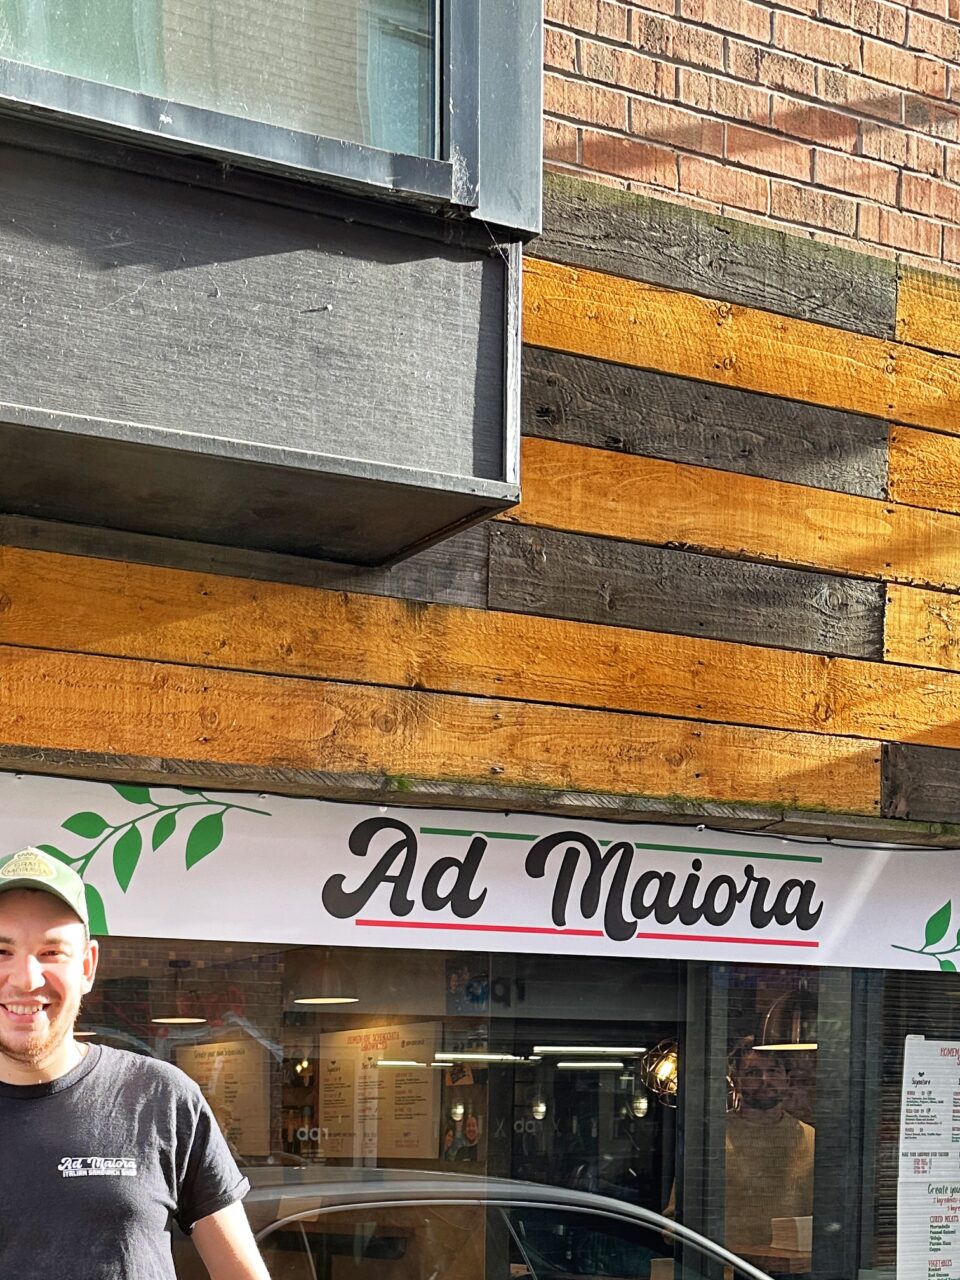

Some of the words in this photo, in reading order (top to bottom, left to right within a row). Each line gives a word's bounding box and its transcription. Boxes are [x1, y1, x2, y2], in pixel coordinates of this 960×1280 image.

[321, 817, 488, 920] Ad
[524, 830, 824, 942] Maiora
[57, 1157, 83, 1171] Ad
[86, 1156, 137, 1170] Maiora
